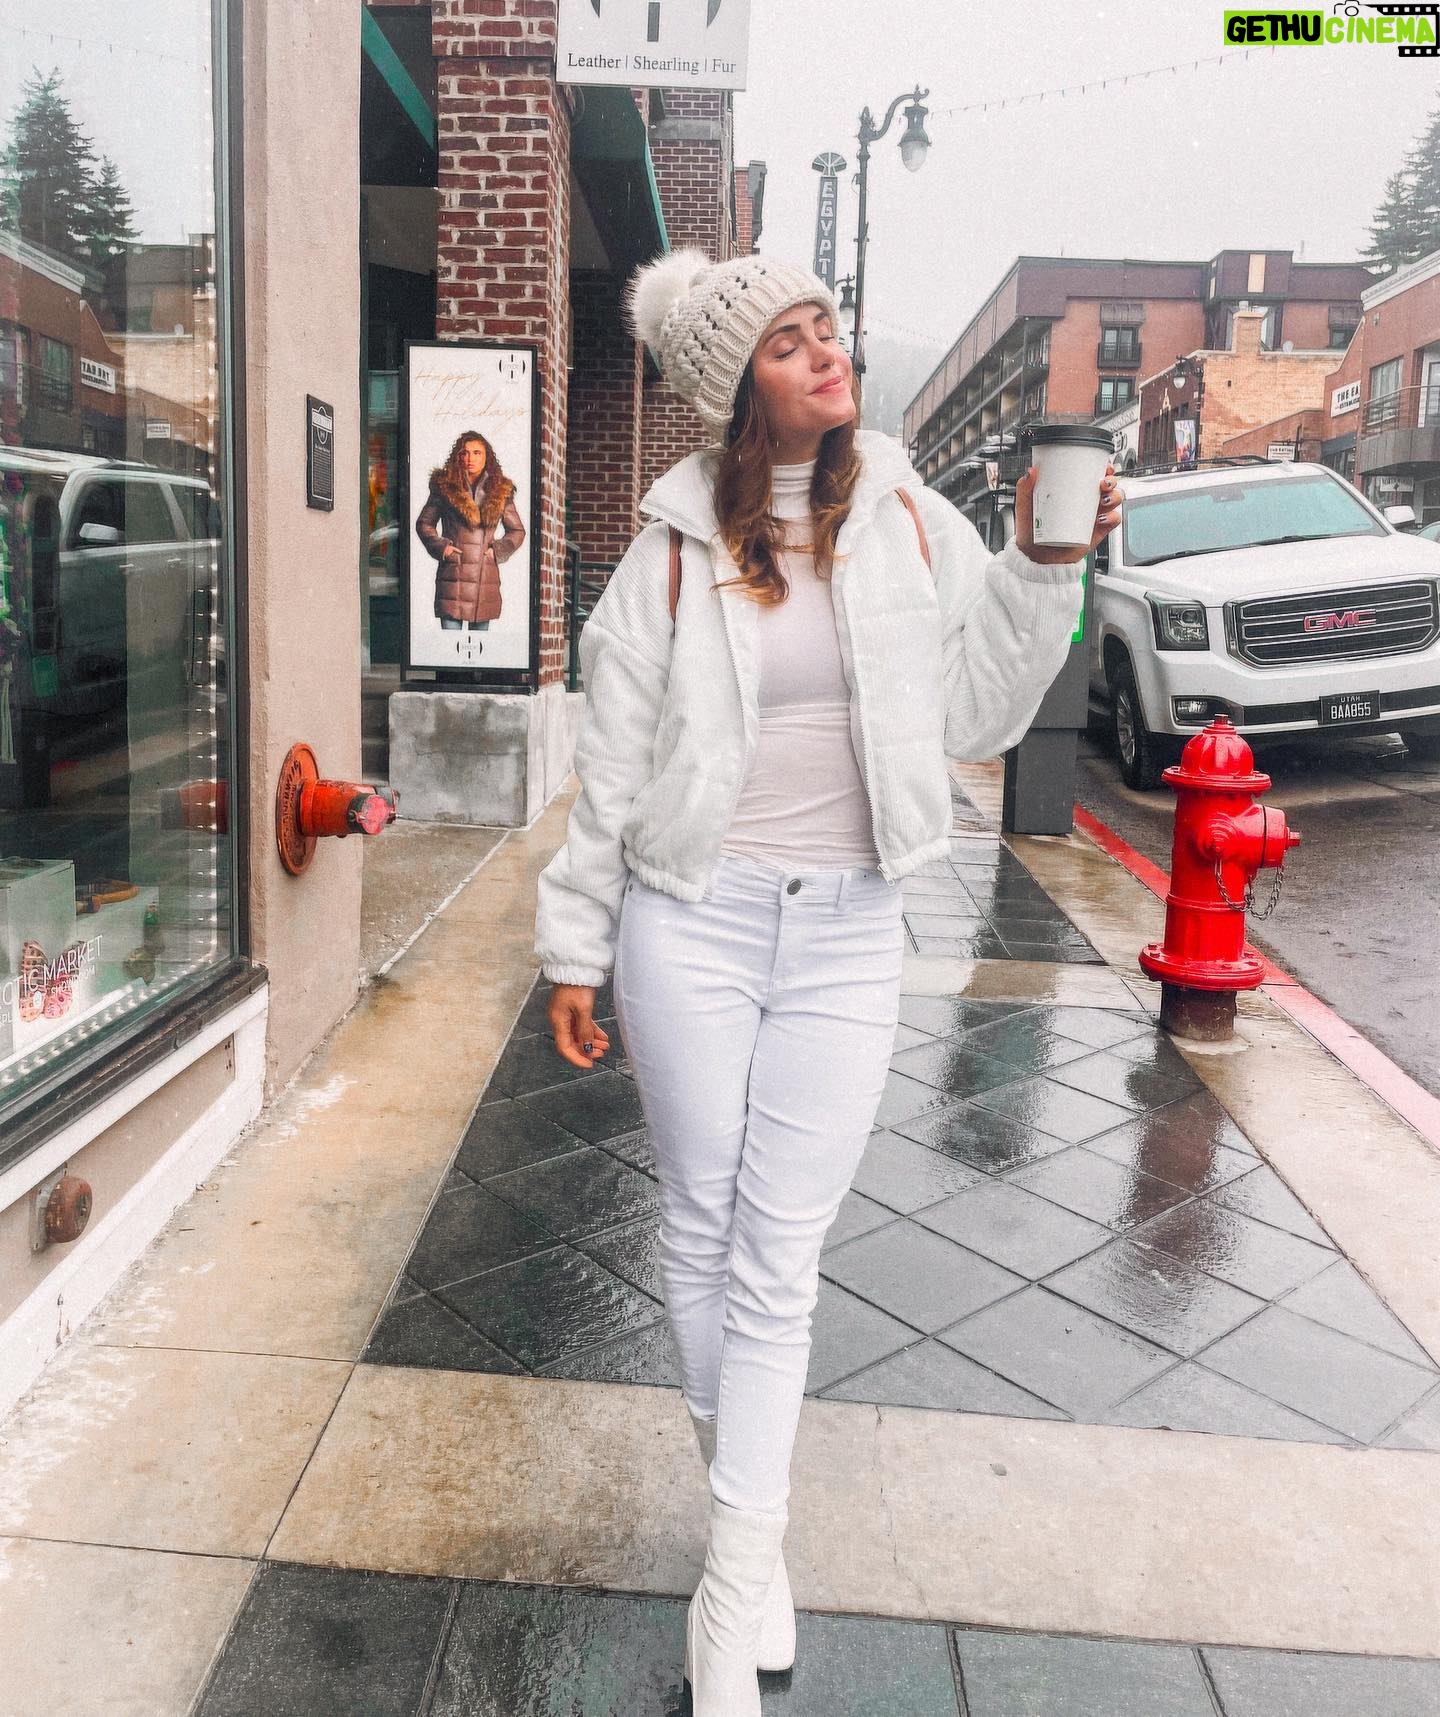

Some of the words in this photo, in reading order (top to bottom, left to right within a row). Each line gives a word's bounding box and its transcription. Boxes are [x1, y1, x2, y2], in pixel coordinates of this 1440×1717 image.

[568, 53, 621, 69] Leather
[633, 56, 699, 75] Shearling
[712, 59, 736, 73] Fur
[1337, 389, 1349, 403] THE
[1304, 608, 1377, 632] GMC
[1340, 695, 1361, 703] UTAH
[44, 935, 102, 989] MARKET
